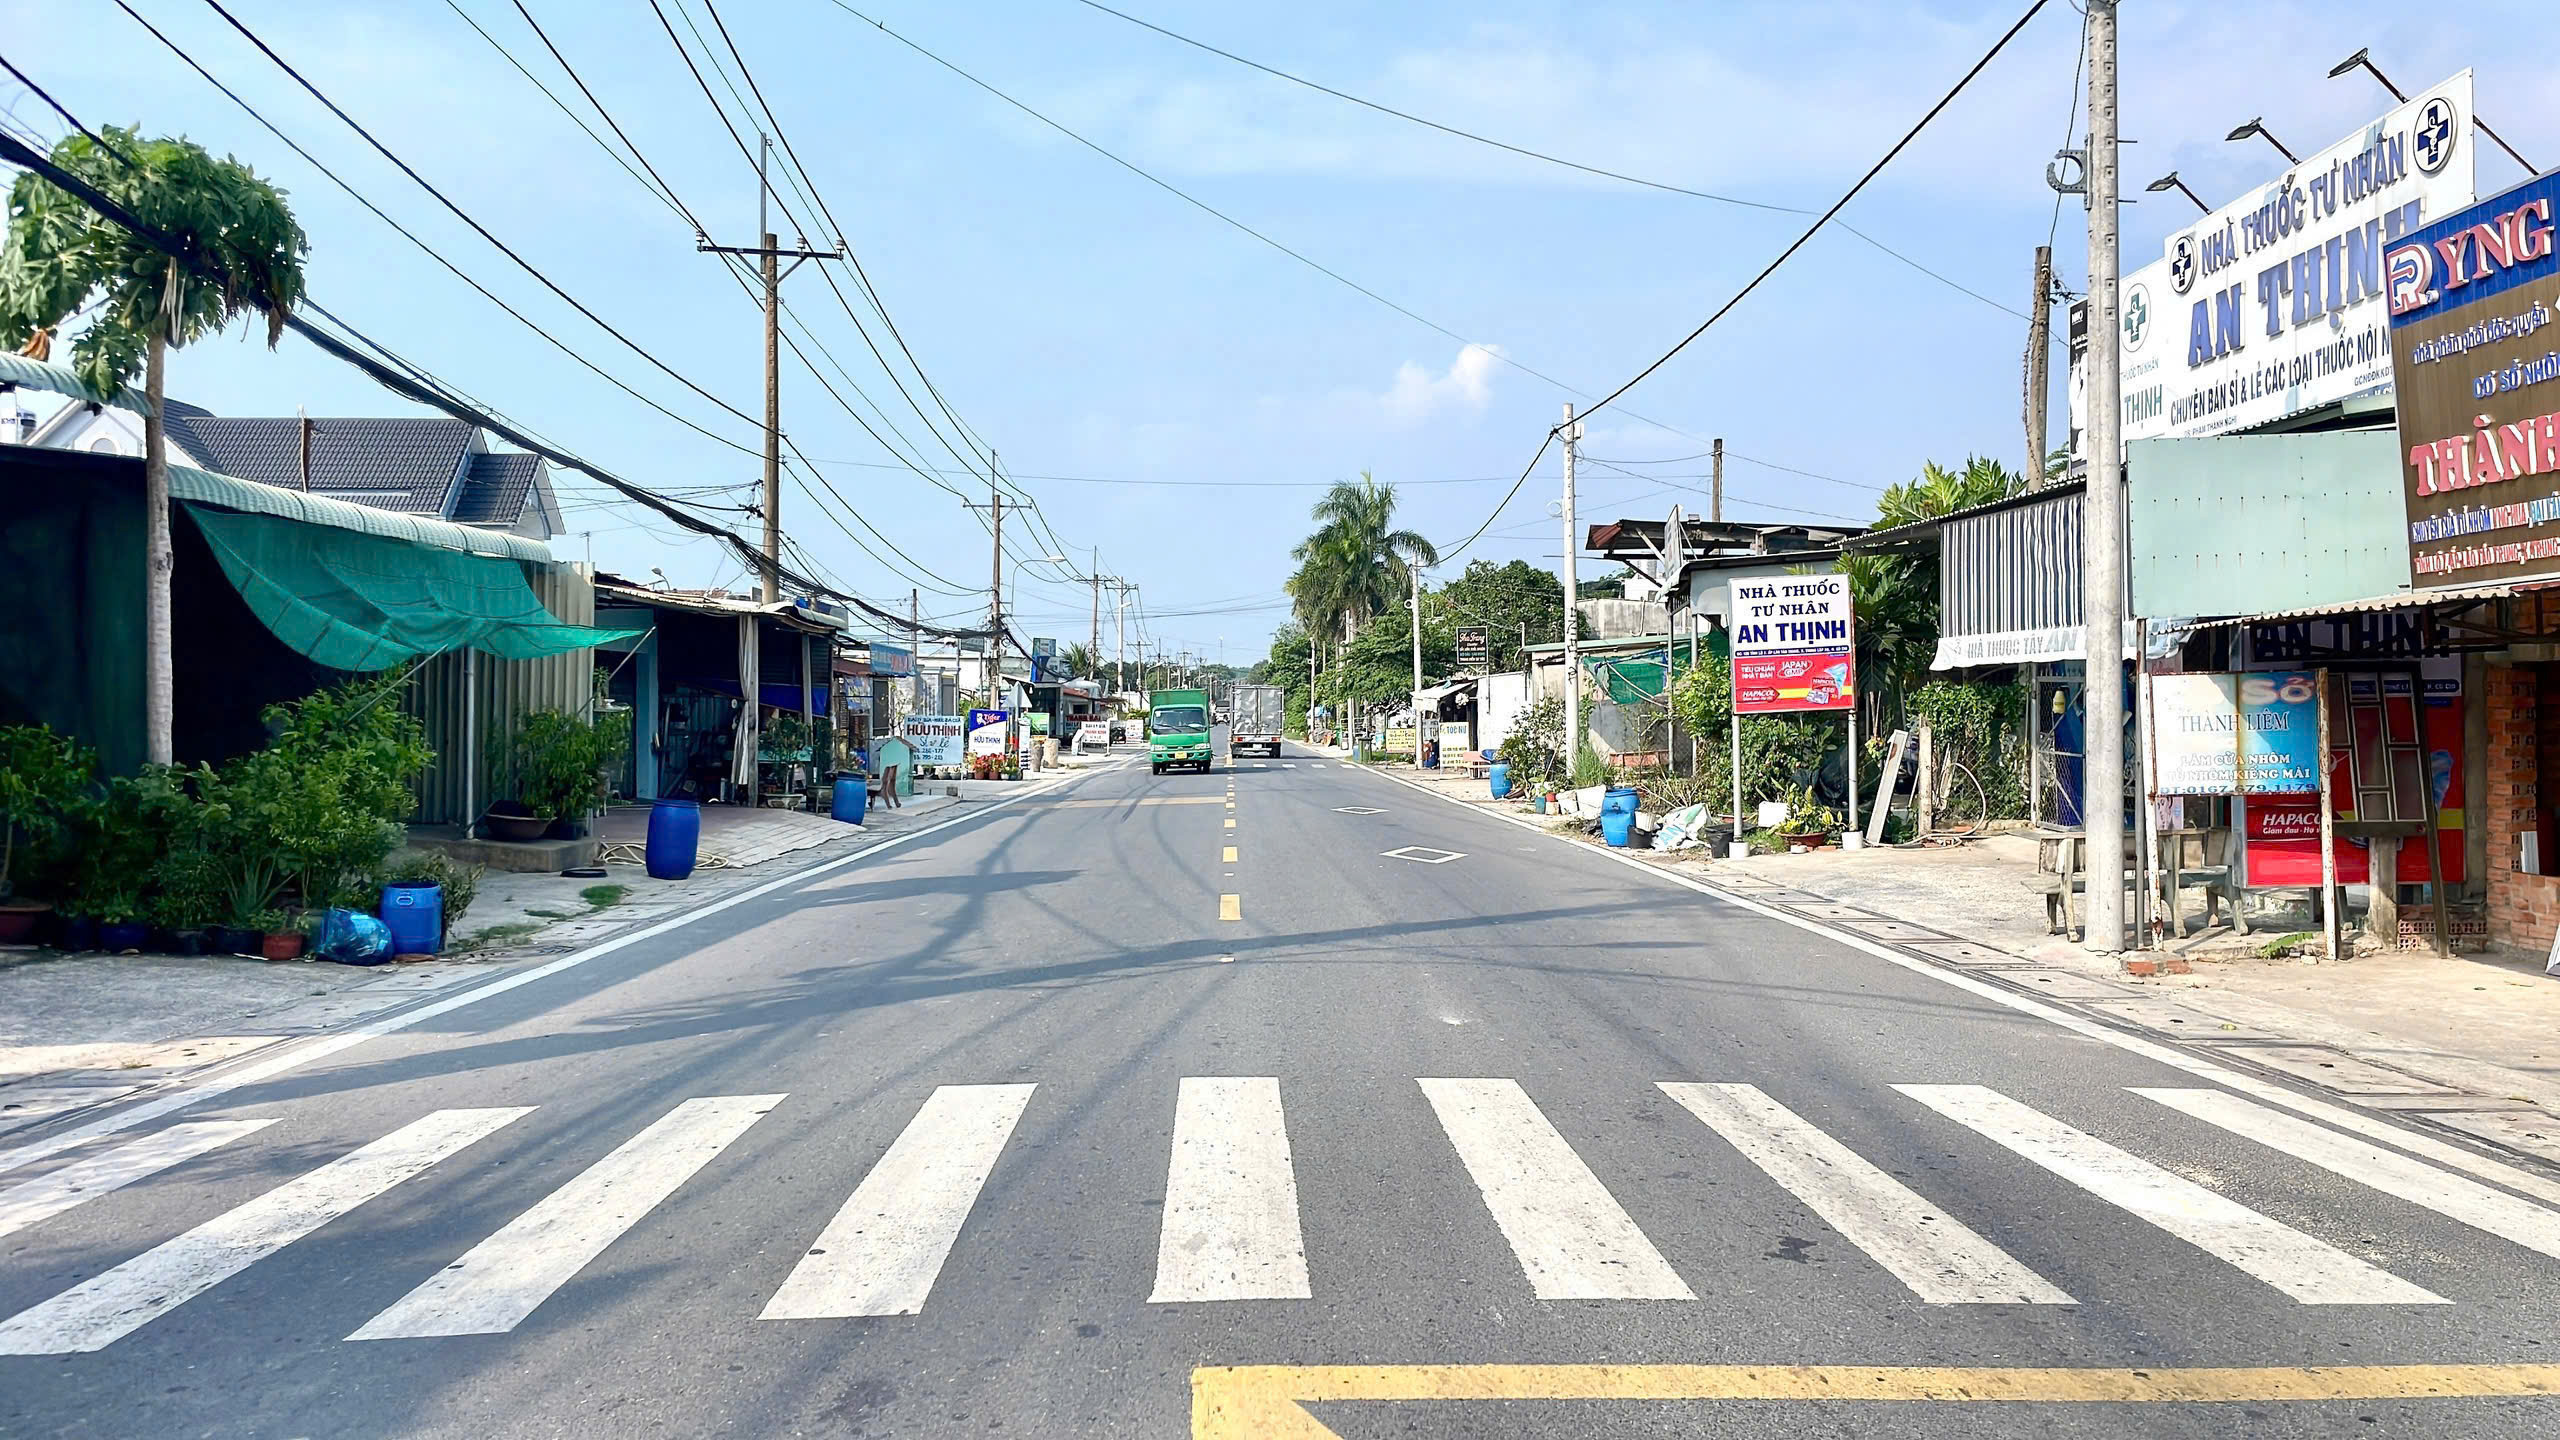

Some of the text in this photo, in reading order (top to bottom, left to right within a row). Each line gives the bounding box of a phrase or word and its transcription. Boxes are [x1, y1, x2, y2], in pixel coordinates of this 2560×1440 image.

[2202, 131, 2409, 277] NHÀ THUỐC TƯ NHÂN
[2188, 282, 2246, 368] AN
[2170, 387, 2207, 426] CHUYÊN
[2208, 379, 2226, 415] BÁN
[2230, 370, 2239, 408] SỈ
[2241, 376, 2248, 402] &
[2265, 358, 2286, 393] CÁC
[2289, 352, 2312, 389] LOẠI
[2316, 326, 2355, 378] THUỐC
[2357, 323, 2378, 369] NỘI
[2124, 384, 2162, 430] THỊNH
[2410, 413, 2560, 496] THÀNH
[1739, 578, 1840, 600] NHÀ THUỐC
[1751, 600, 1829, 617] TƯ NHÂN
[1737, 619, 1846, 645] AN THỊNH
[2044, 629, 2079, 653] AN
[2255, 621, 2312, 657] AN
[1782, 660, 1808, 670] JAPAN
[2241, 676, 2315, 706] SỞ
[931, 722, 962, 739] THỊNH
[983, 713, 1001, 724] Tiger
[2180, 707, 2290, 732] THÀNH LIÊM
[2181, 749, 2291, 766] LÀM CỬA NHÔM
